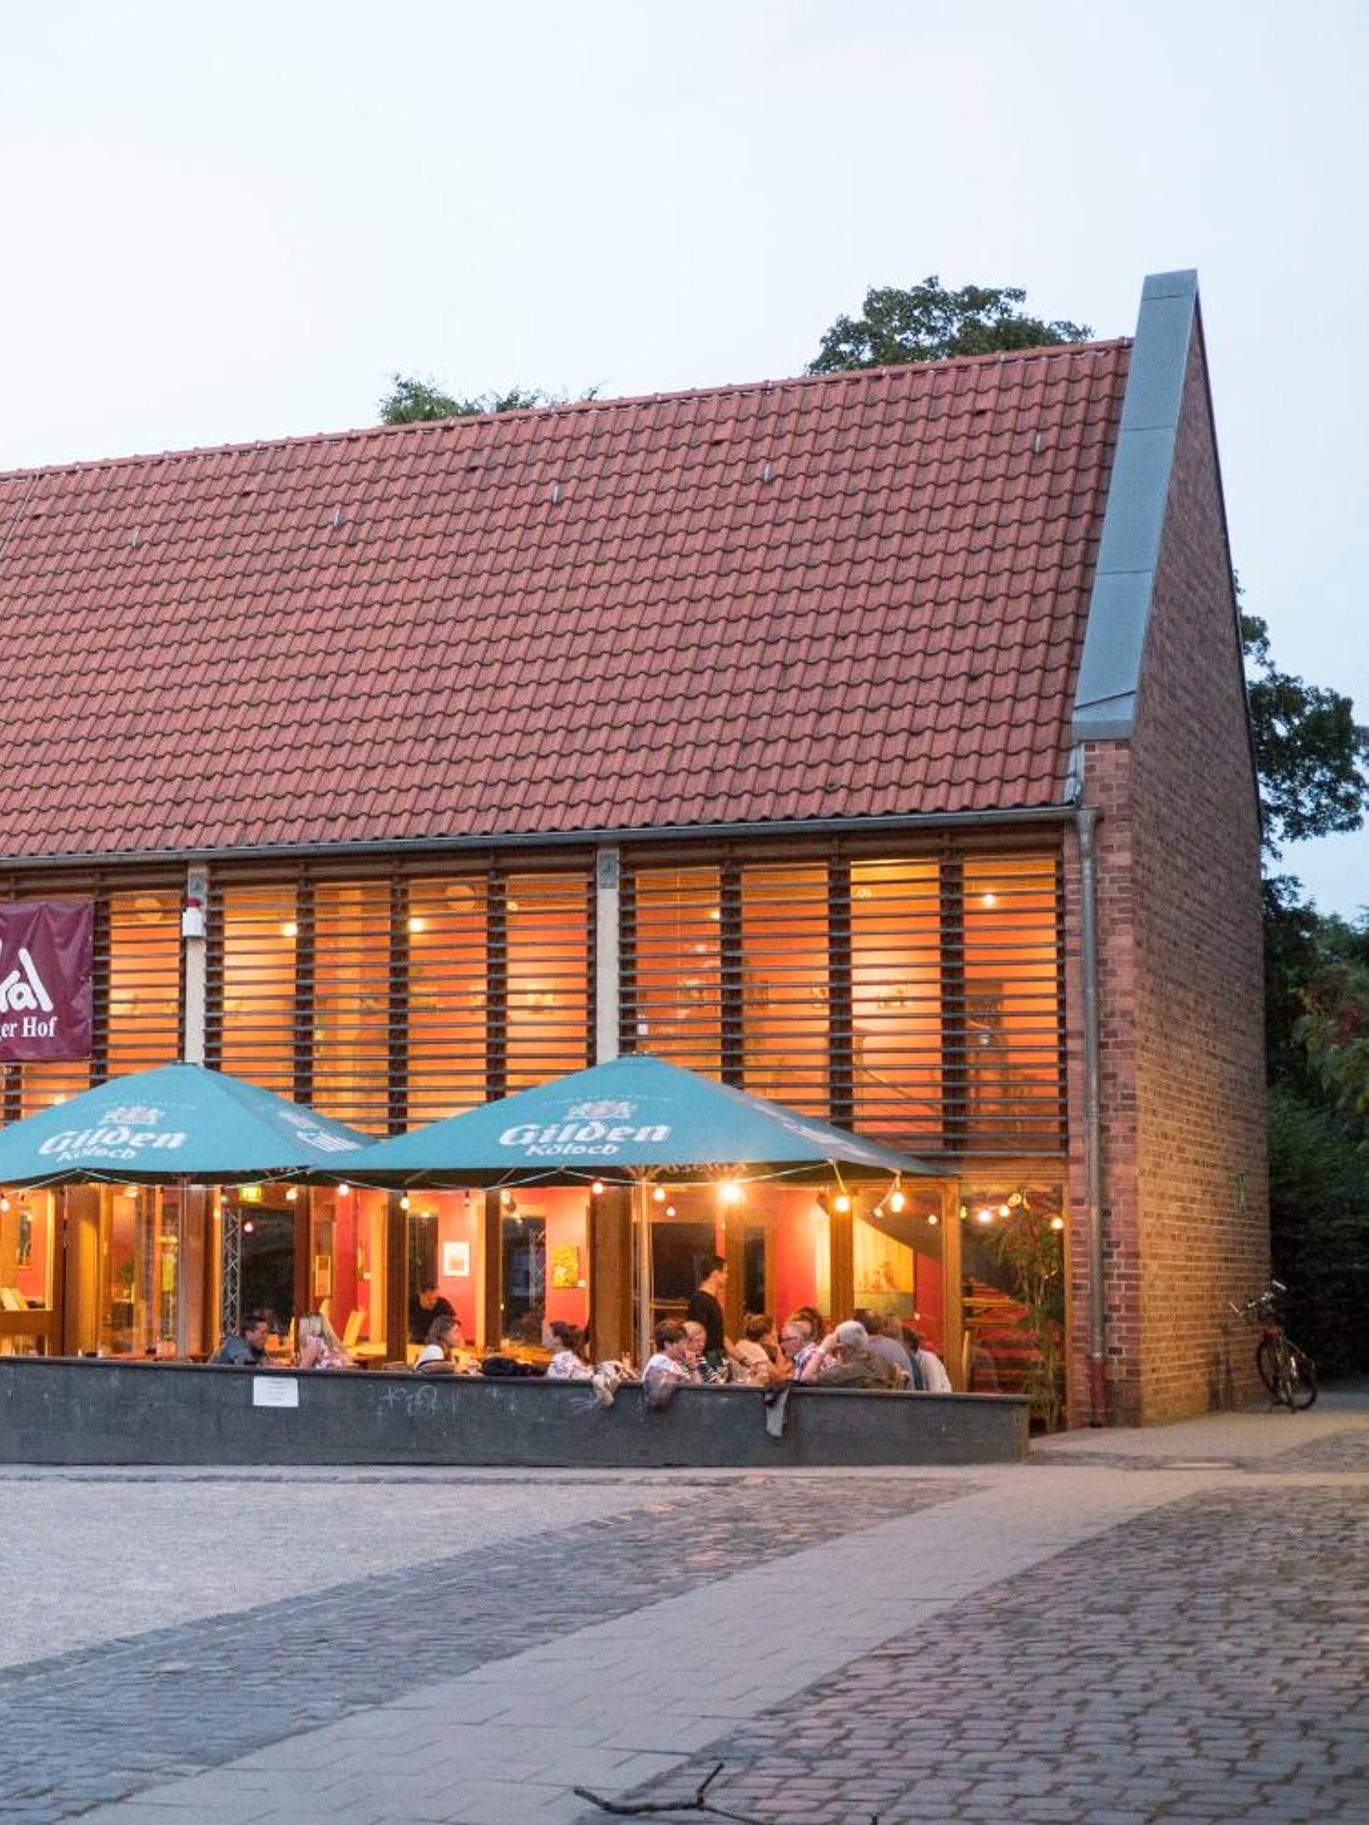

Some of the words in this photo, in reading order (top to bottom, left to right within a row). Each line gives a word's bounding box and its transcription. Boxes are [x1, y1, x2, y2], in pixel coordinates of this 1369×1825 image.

[22, 1016, 58, 1038] Hof
[39, 1125, 187, 1155] Gilden
[499, 1121, 672, 1146] Gilden
